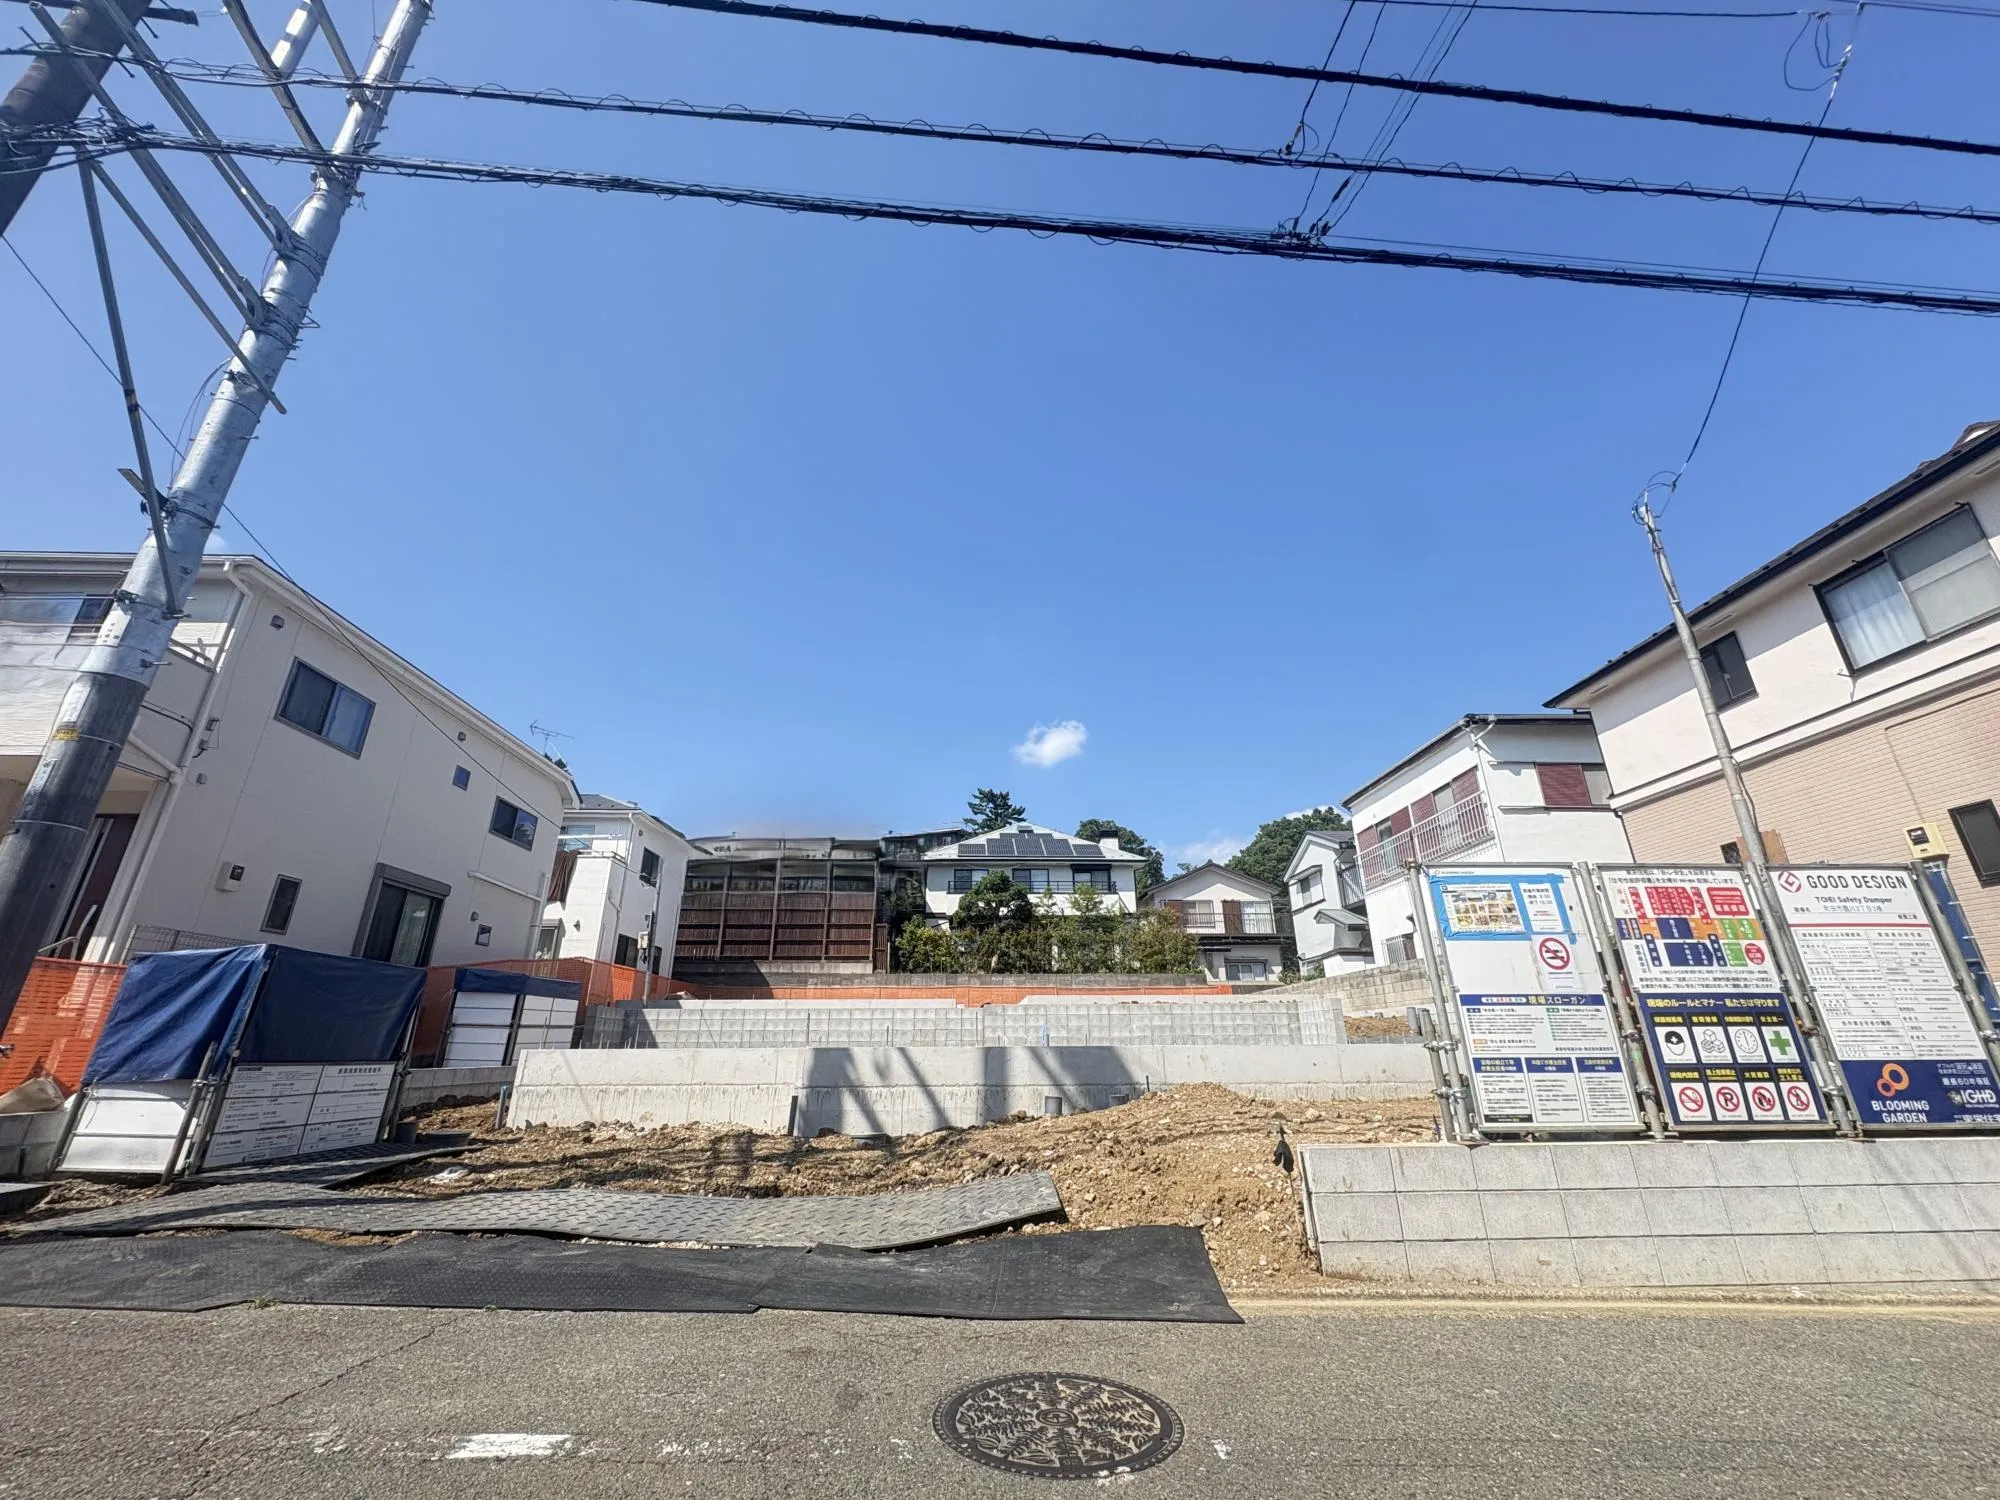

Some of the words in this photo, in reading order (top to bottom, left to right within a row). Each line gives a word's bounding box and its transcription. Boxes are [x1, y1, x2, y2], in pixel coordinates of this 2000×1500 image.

[1806, 875, 1849, 889] GOOD
[1851, 875, 1908, 889] DESIGN
[1838, 896, 1862, 904] Safety
[1863, 896, 1893, 904] Damper
[1528, 996, 1586, 1004] 現場スローガン
[1646, 998, 1723, 1007] 現場のルールとマナー
[1725, 998, 1780, 1007] 私たちは守ります
[1871, 1100, 1930, 1111] BLOOMING
[1882, 1112, 1928, 1123] GARDEN
